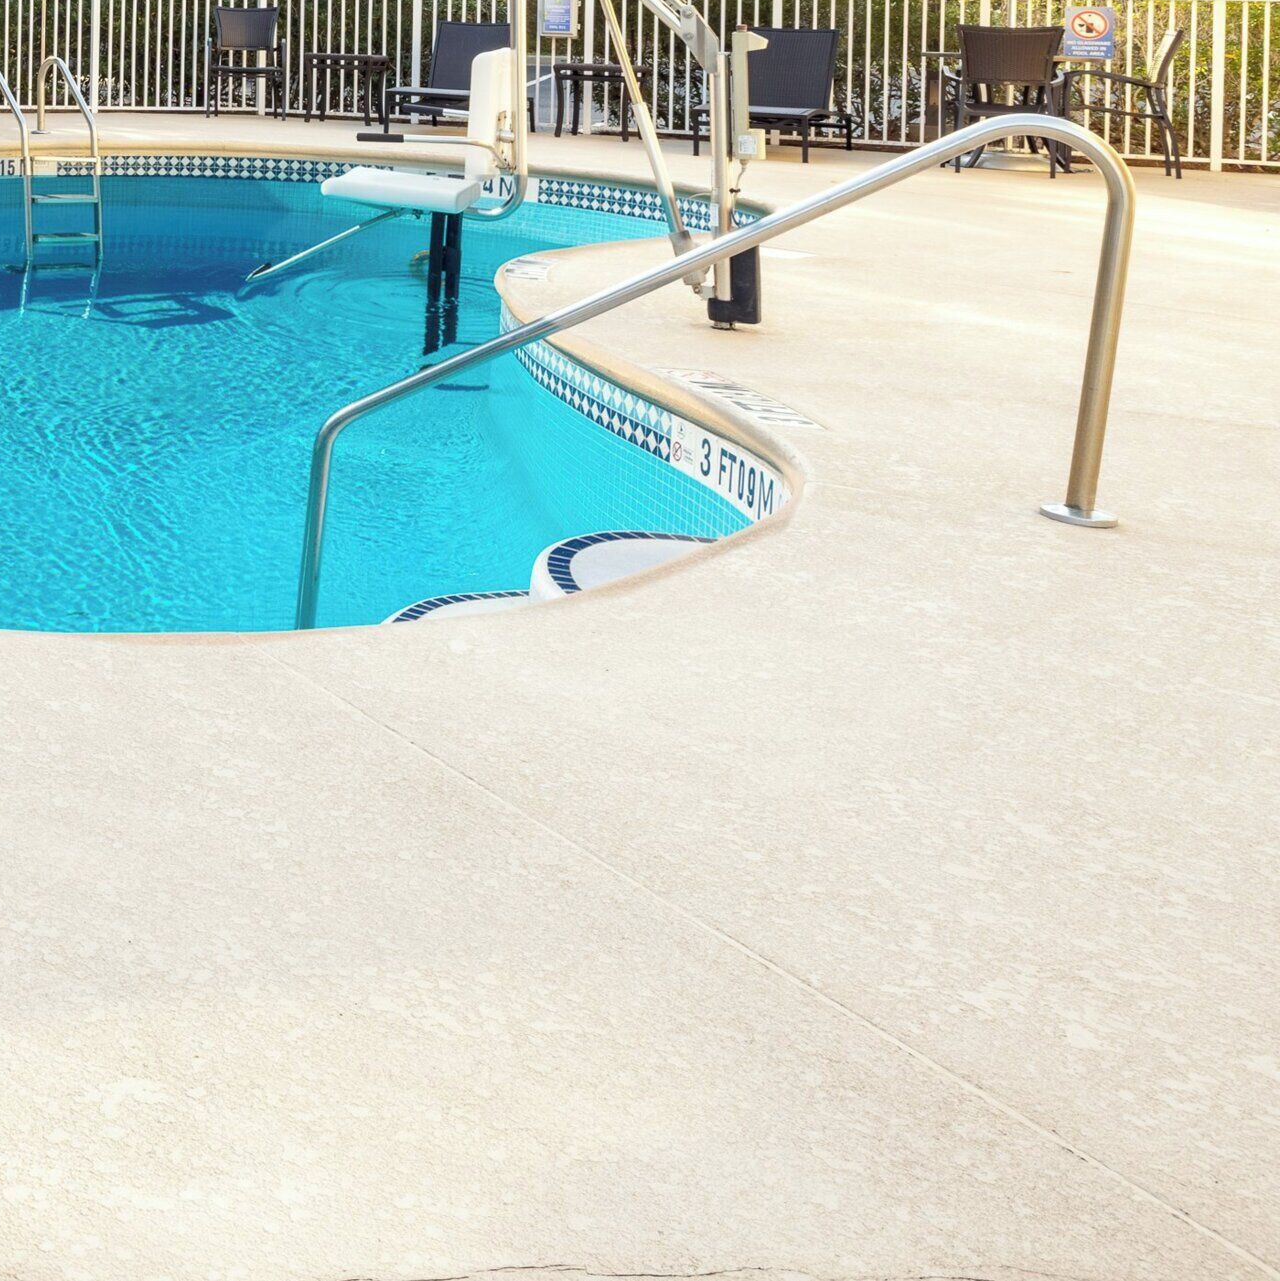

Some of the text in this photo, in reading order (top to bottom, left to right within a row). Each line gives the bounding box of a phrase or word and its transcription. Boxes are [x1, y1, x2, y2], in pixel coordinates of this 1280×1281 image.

[700, 438, 711, 477] 3
[718, 447, 737, 493] FT
[757, 470, 774, 520] M
